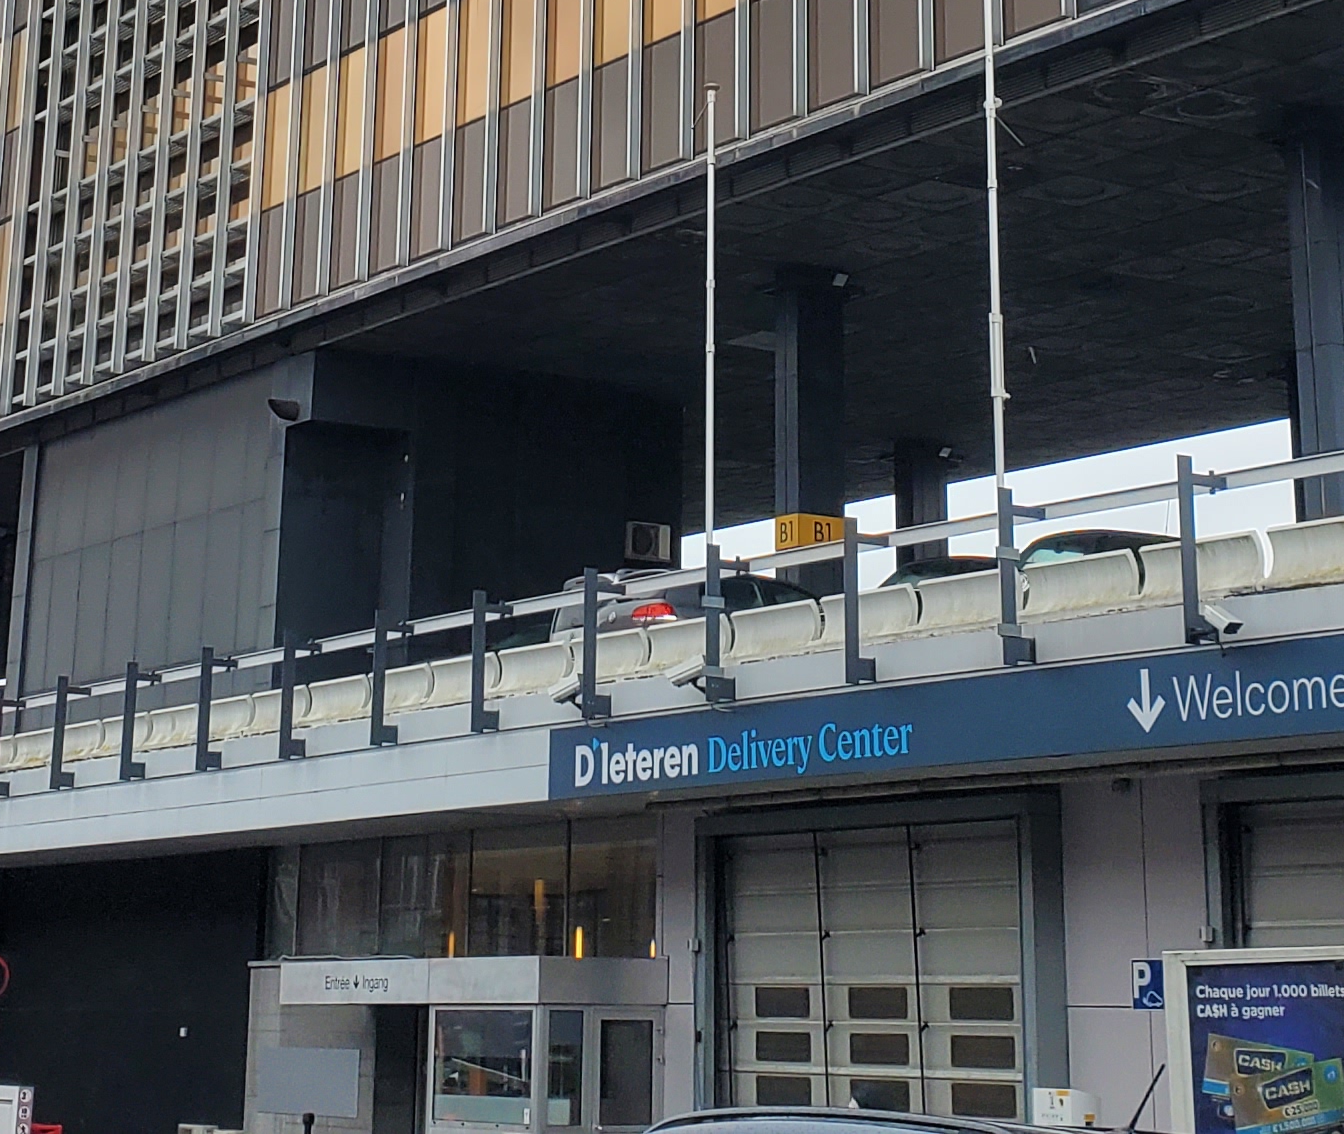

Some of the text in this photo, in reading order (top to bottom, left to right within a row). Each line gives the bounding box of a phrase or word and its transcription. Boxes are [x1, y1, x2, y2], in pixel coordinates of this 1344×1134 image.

[780, 521, 793, 543] B1
[814, 521, 831, 542] B1
[707, 730, 813, 774] Delivery
[818, 723, 913, 762] Center
[362, 975, 389, 993] Ingang
[1132, 961, 1152, 998] P
[1196, 985, 1244, 1000] Chaque
[1244, 984, 1271, 1000] jour
[1272, 984, 1307, 998] 1.000
[1231, 1003, 1239, 1017] à
[1241, 1006, 1286, 1019] gagner
